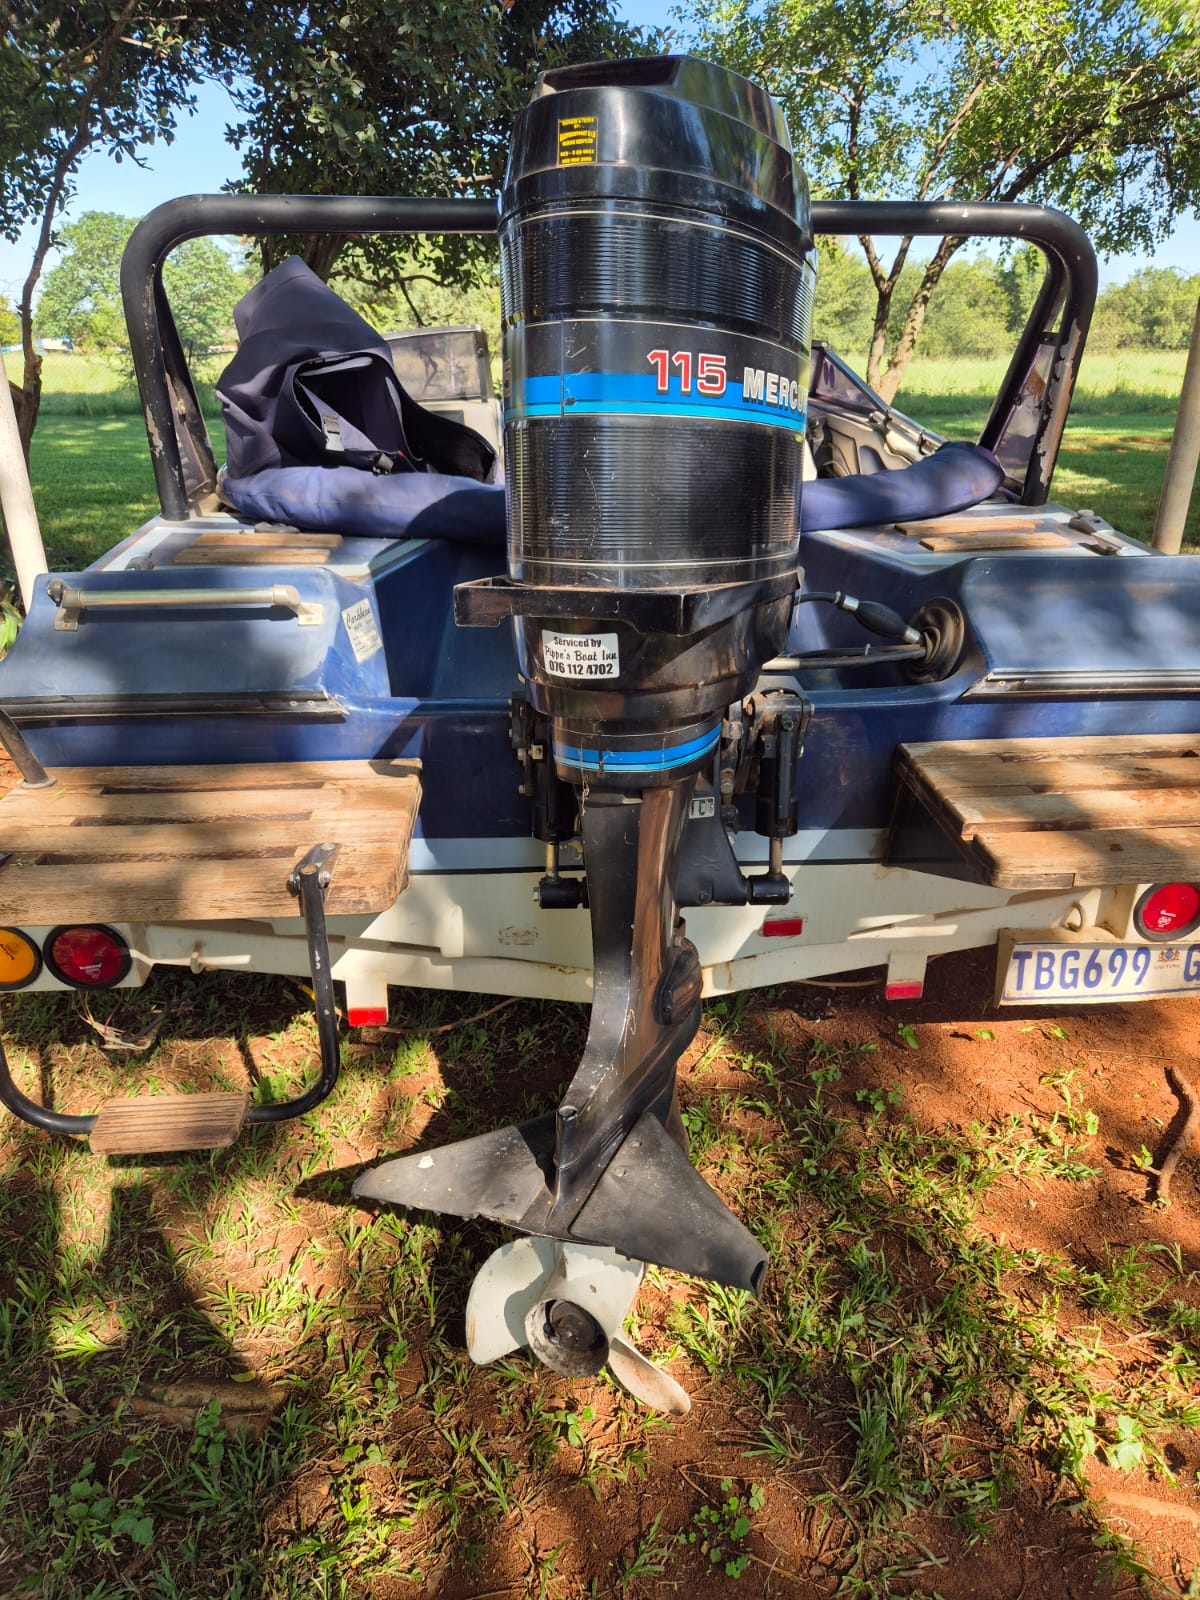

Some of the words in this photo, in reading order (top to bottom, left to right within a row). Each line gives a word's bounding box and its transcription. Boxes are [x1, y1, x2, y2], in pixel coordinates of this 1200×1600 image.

[646, 350, 727, 398] 115
[553, 636, 590, 648] Serviced
[591, 638, 602, 648] by
[574, 650, 598, 662] Boat
[602, 649, 618, 660] Inn
[549, 660, 566, 674] 076
[567, 663, 584, 675] 112
[585, 663, 614, 676] 4702
[1012, 946, 1151, 992] TBG699
